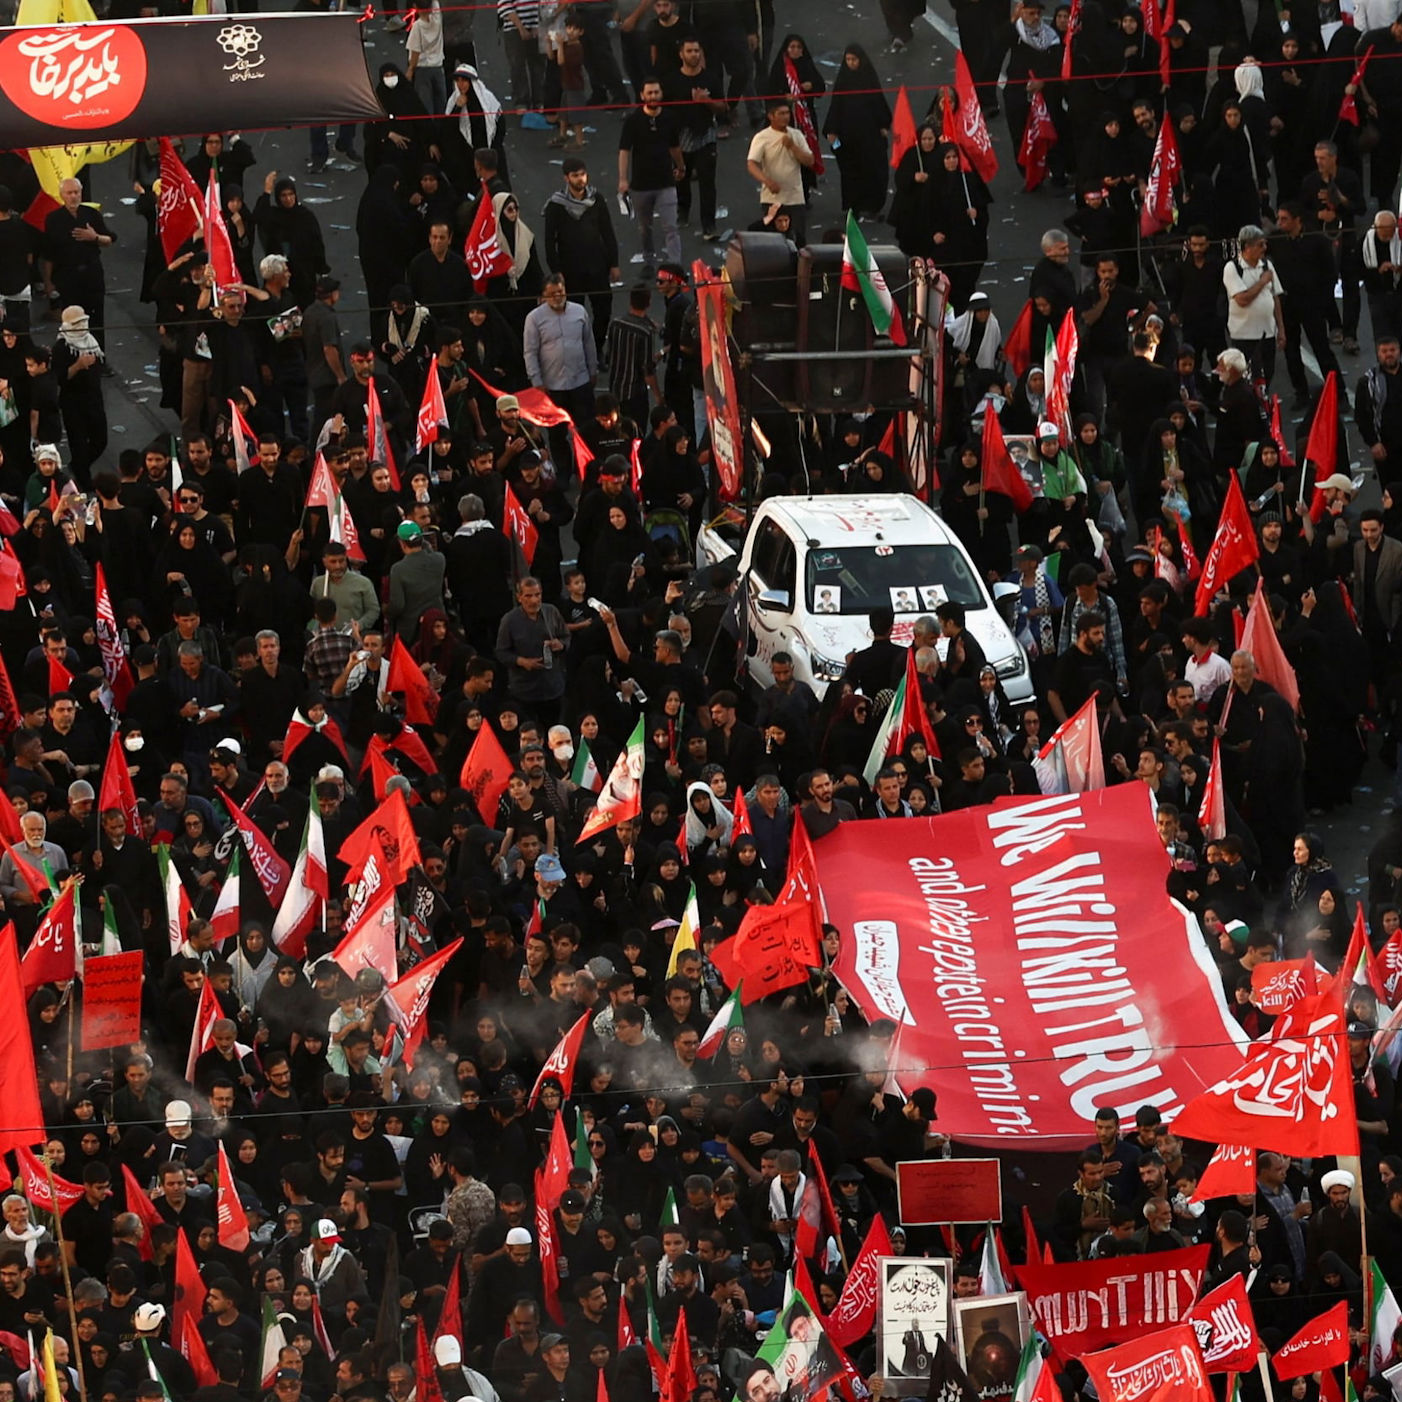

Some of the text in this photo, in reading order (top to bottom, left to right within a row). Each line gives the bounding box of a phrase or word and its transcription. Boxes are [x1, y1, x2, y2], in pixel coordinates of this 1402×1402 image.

[907, 856, 986, 896] and
[918, 940, 1004, 1020] epstein
[987, 793, 1185, 1130] We Will Kill TRU
[1262, 994, 1282, 1006] kill
